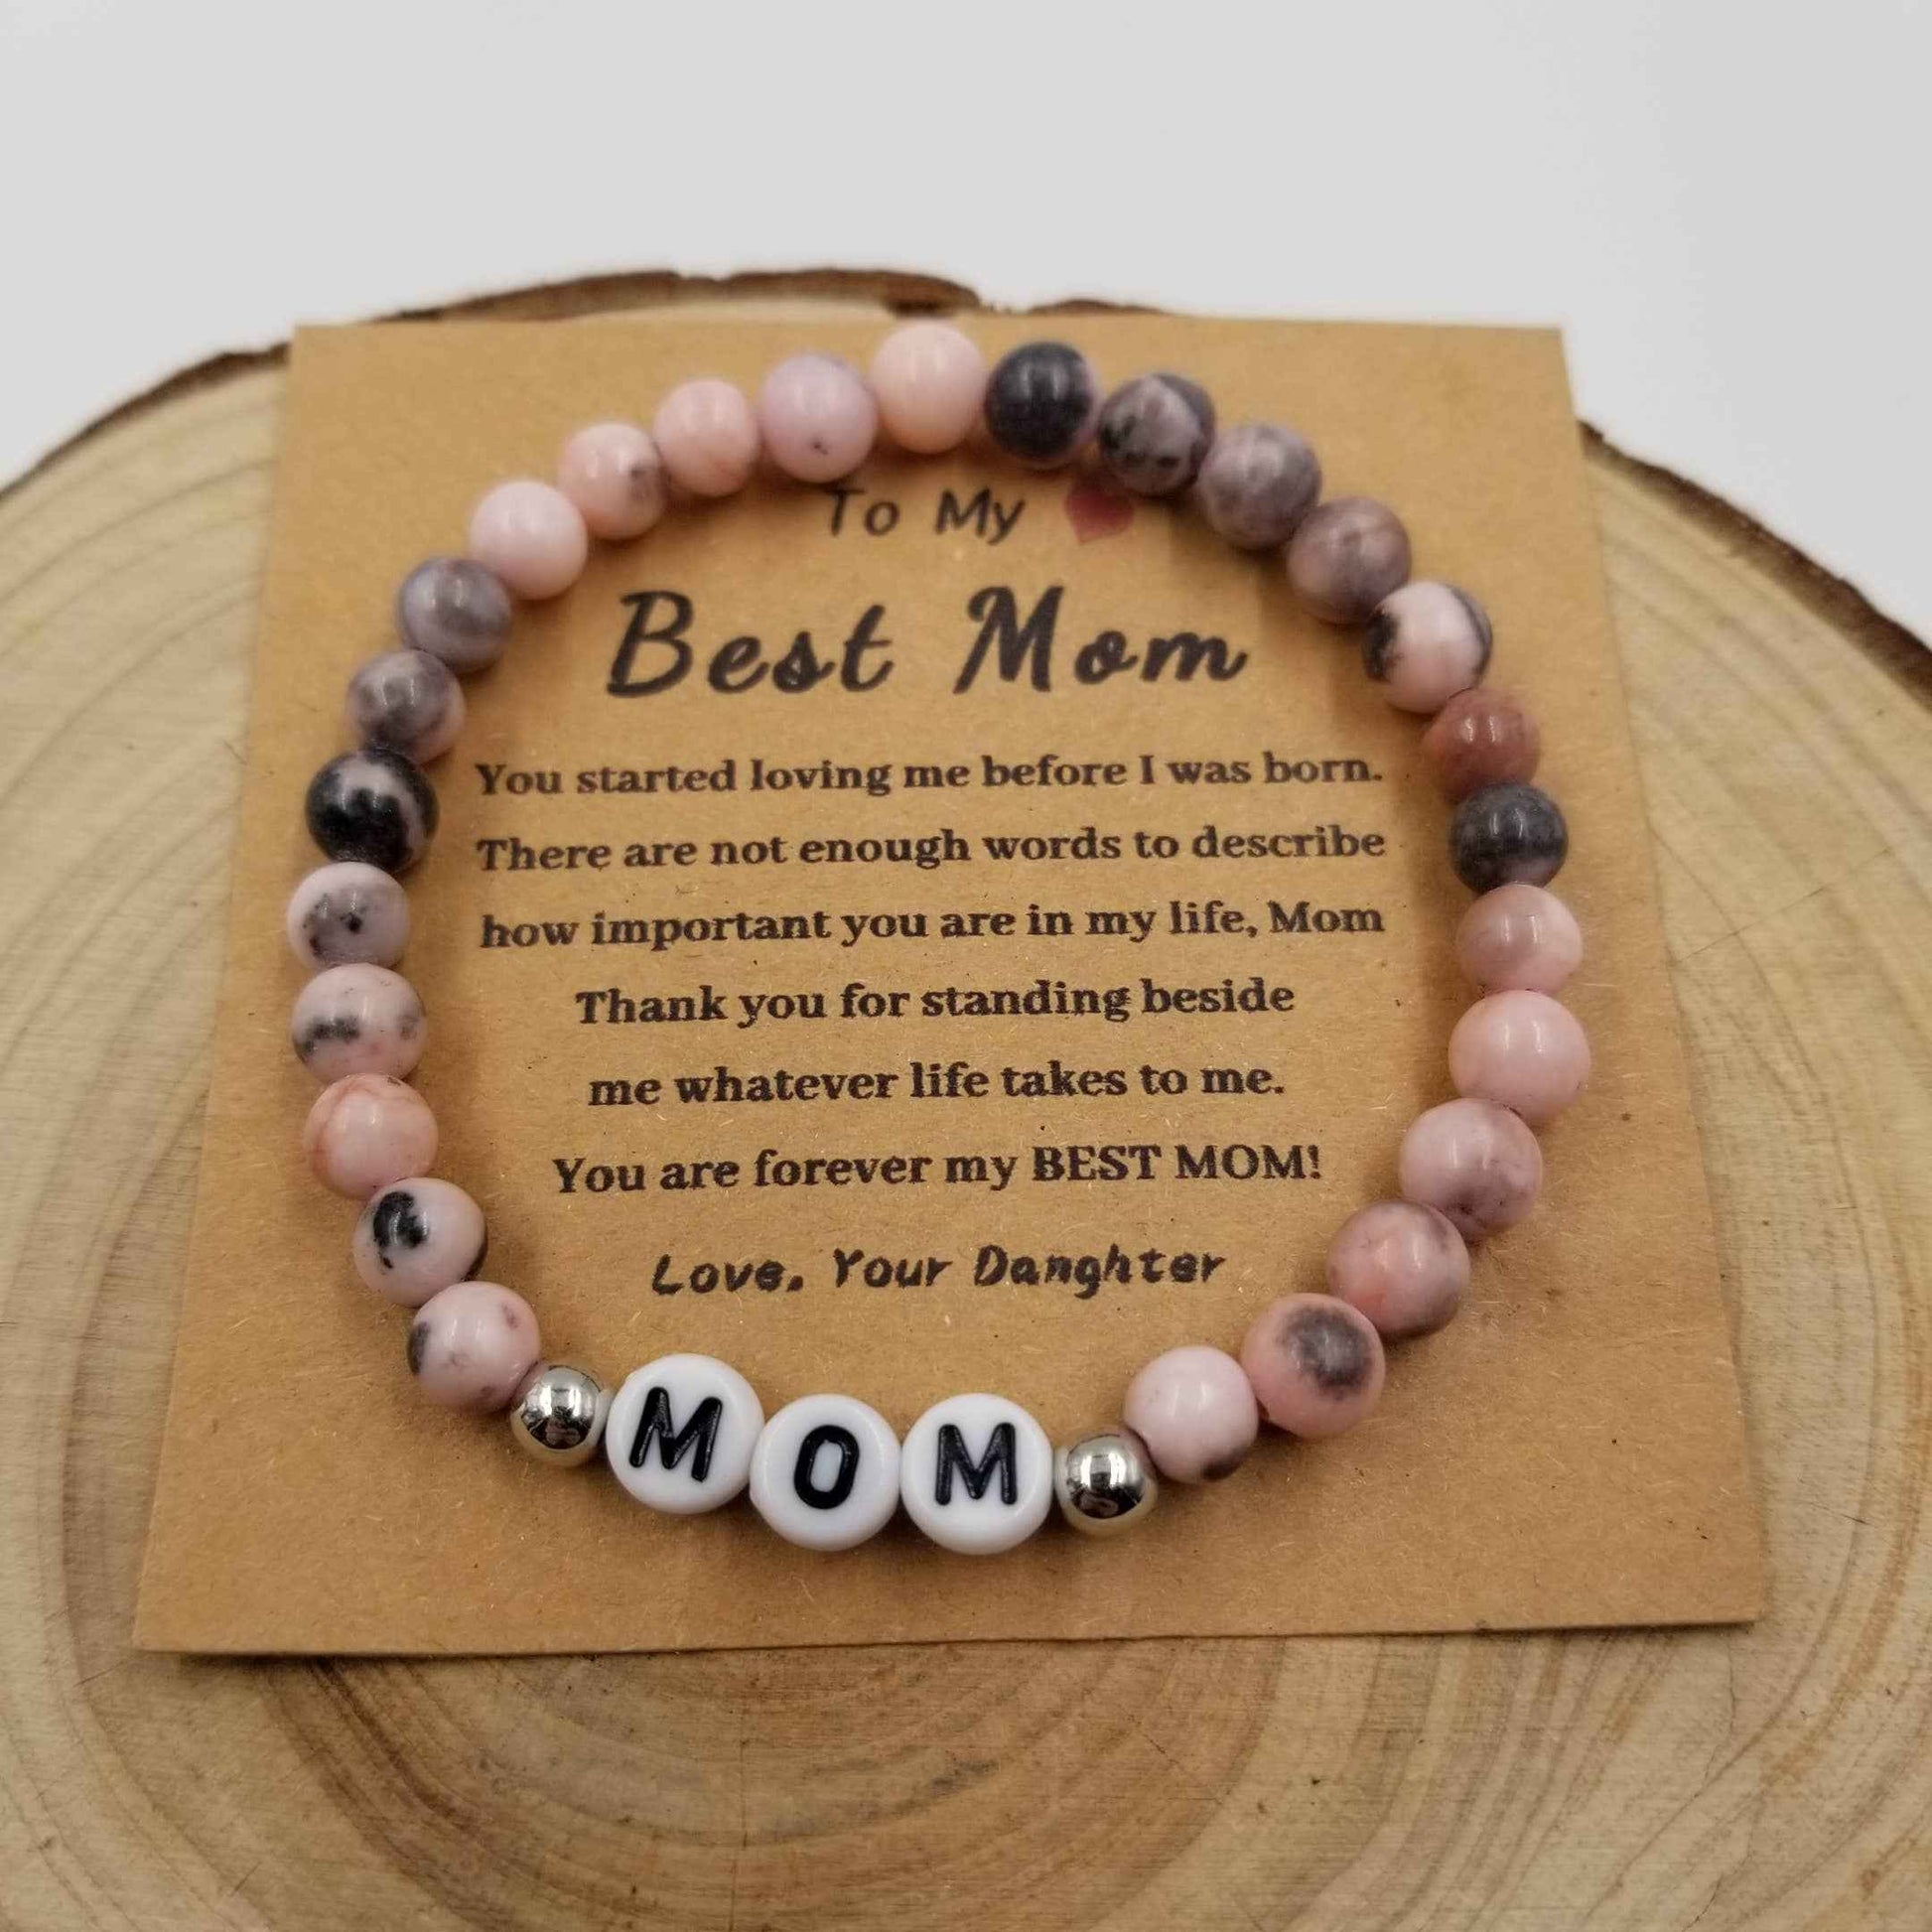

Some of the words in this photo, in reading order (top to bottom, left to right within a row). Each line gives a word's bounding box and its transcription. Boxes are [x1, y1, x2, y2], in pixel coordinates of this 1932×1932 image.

[827, 484, 900, 536] To
[935, 485, 1026, 545] My
[607, 592, 894, 698] Best
[953, 584, 1248, 695] Mom
[476, 764, 562, 794] You
[577, 759, 736, 793] started
[751, 759, 892, 796] loving
[903, 766, 970, 787] me
[982, 755, 1127, 786] before
[1140, 755, 1155, 784] I
[1167, 761, 1251, 784] was
[1263, 751, 1382, 783] born.
[477, 838, 611, 871] There
[623, 843, 697, 867] are
[711, 837, 787, 866] not
[799, 829, 971, 870] enough
[982, 827, 1121, 860] words
[1134, 832, 1179, 859] to
[1192, 825, 1385, 858] describe
[481, 914, 579, 948] how
[592, 910, 832, 951] important
[841, 913, 929, 947] you
[940, 913, 1016, 938] are
[1027, 903, 1074, 935] in
[1085, 910, 1157, 943] my
[1170, 900, 1258, 938] life,
[1267, 900, 1385, 933] Mom
[575, 985, 728, 1024] Thank
[738, 993, 827, 1029] you
[840, 983, 909, 1019] for
[920, 980, 1131, 1023] standing
[1140, 977, 1295, 1014] beside
[588, 1079, 661, 1106] me
[674, 1066, 898, 1103] whatever
[910, 1061, 989, 1098] life
[1001, 1060, 1128, 1097] takes
[1139, 1065, 1187, 1095] to
[1200, 1068, 1284, 1095] me.
[552, 1158, 645, 1193] You
[660, 1162, 740, 1190] are
[754, 1150, 933, 1186] forever
[943, 1157, 1018, 1191] my
[1033, 1145, 1162, 1181] BEST
[1174, 1145, 1321, 1179] MOM!
[833, 1248, 952, 1289] Your
[628, 1387, 1018, 1510] MOM
